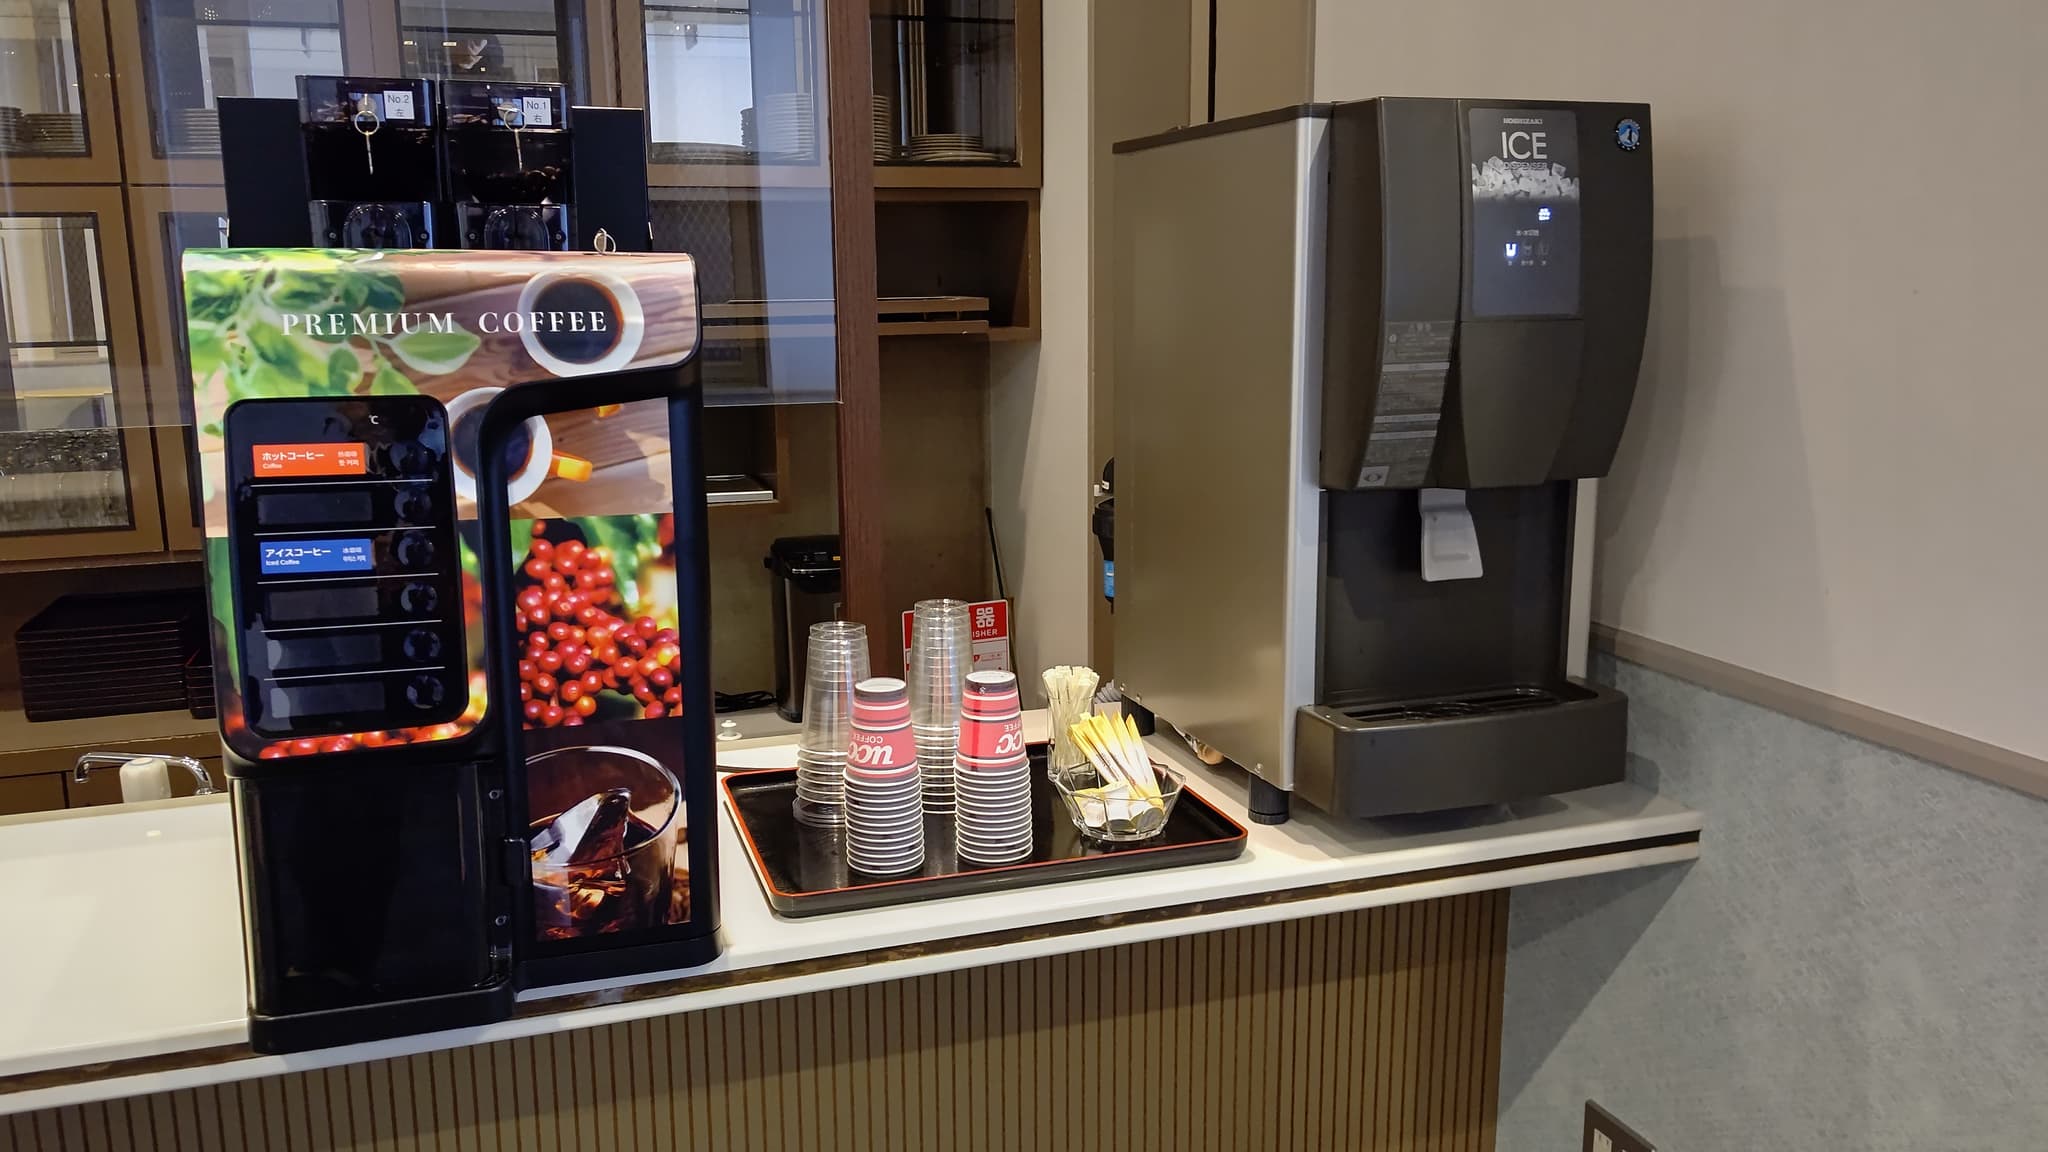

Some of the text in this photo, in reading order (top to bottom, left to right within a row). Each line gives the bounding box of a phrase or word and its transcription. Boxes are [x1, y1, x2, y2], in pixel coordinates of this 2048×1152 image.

[387, 94, 409, 104] No.2
[526, 100, 547, 110] No.1
[1501, 131, 1548, 160] ICE
[280, 310, 608, 336] PREMIUM COFFEE
[262, 451, 325, 461] ホットコーヒー
[265, 547, 332, 558] アイスコーヒー
